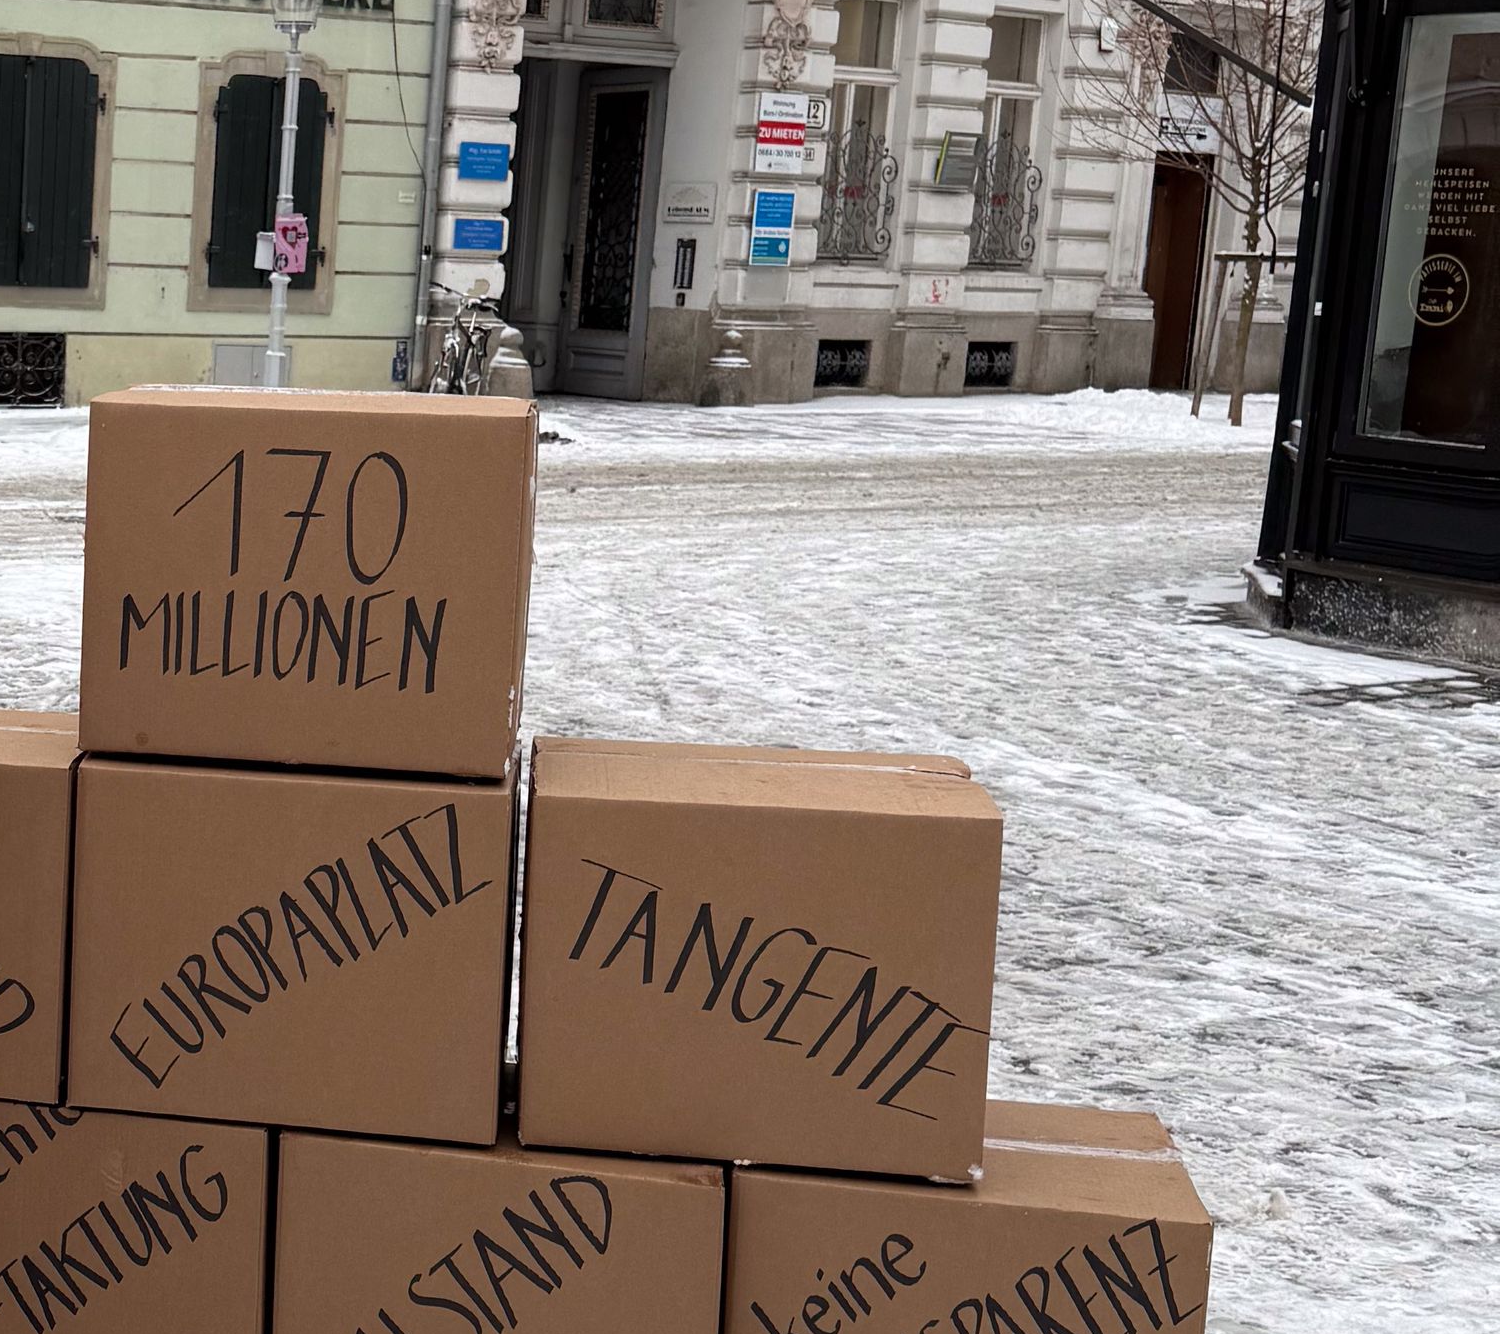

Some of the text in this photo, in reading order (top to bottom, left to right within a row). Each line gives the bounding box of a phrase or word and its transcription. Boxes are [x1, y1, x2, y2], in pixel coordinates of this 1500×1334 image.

[758, 126, 805, 140] ZU MIETEN
[1433, 168, 1475, 176] UNSERE
[1466, 192, 1485, 201] MIT
[1436, 203, 1459, 213] VIEL
[1464, 204, 1496, 213] LIEBE
[1428, 215, 1468, 224] SELBST
[173, 448, 408, 585] 170
[119, 589, 448, 694] MILLIONEN
[109, 803, 493, 1090] EUROPAPLATZ
[568, 858, 990, 1121] TANGENTE
